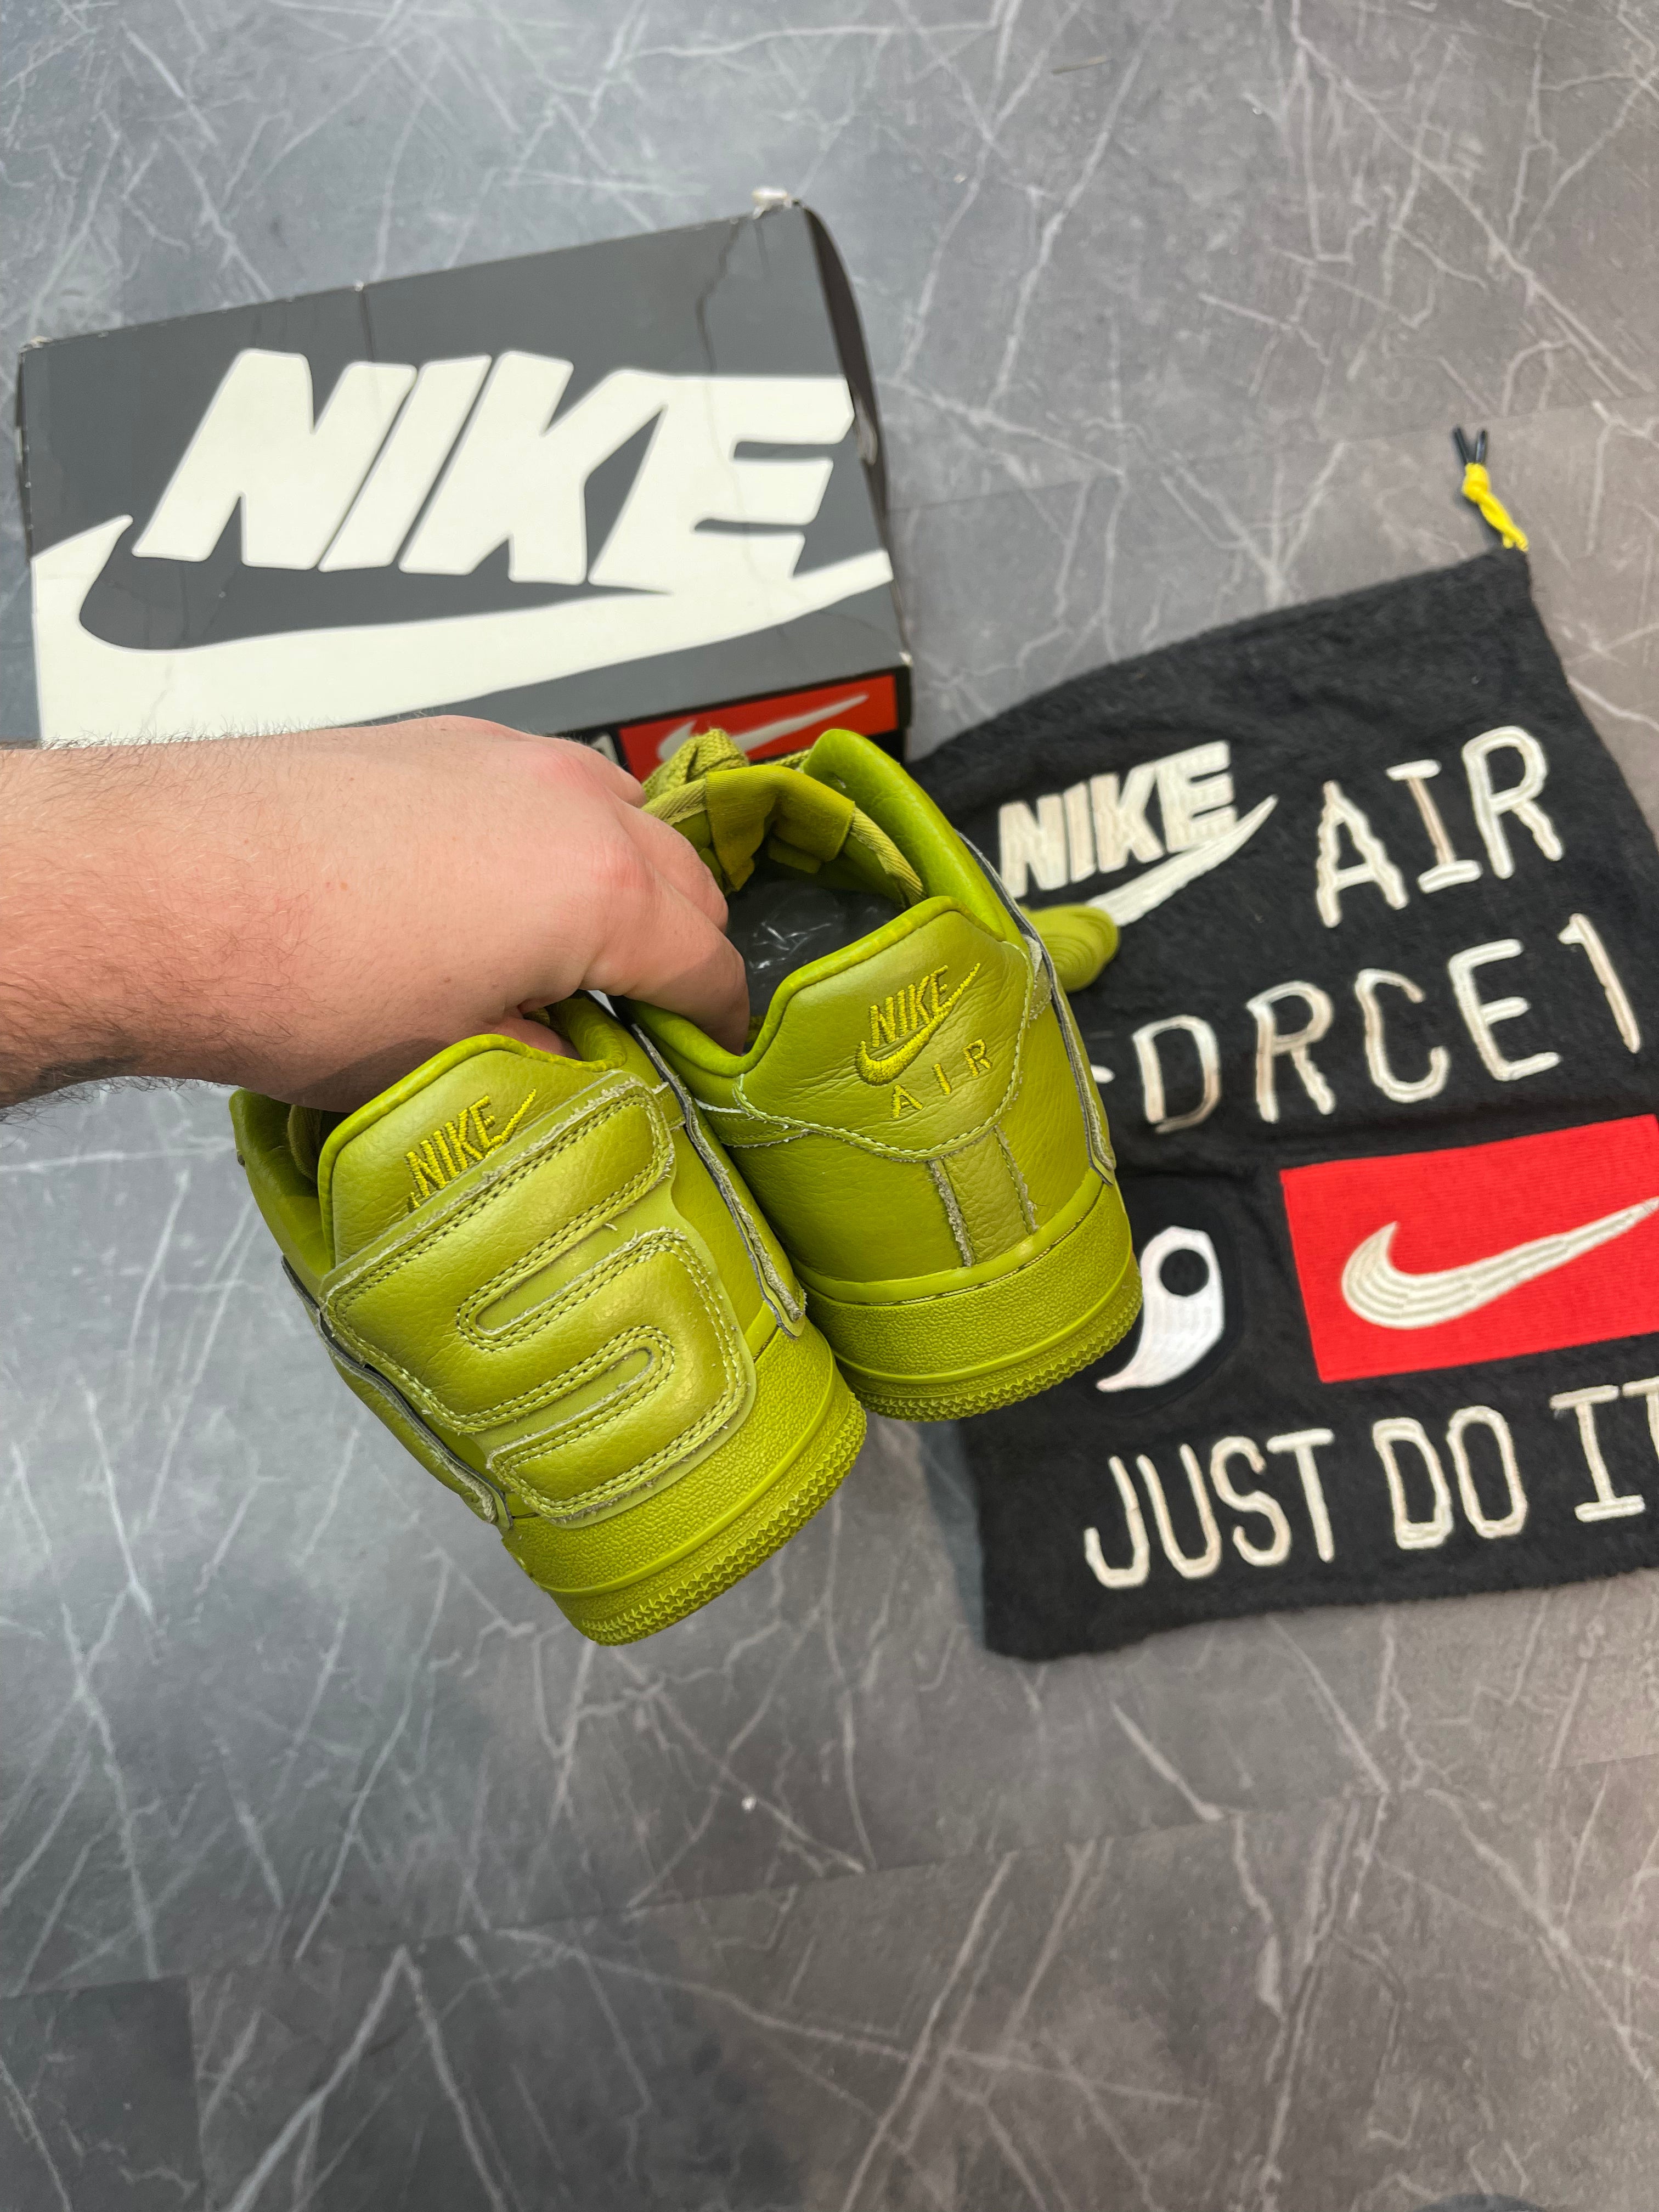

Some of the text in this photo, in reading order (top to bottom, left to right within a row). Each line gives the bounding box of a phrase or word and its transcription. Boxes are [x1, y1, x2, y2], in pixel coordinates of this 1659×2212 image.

[132, 348, 854, 592] NIKE
[999, 740, 1238, 899] NIKE
[1316, 725, 1564, 928] AIR
[870, 964, 953, 1048] NIKE
[891, 1039, 992, 1119] AIR
[405, 1094, 500, 1198] NIKE
[1084, 1427, 1335, 1589] JUST
[1372, 1405, 1528, 1550] DO
